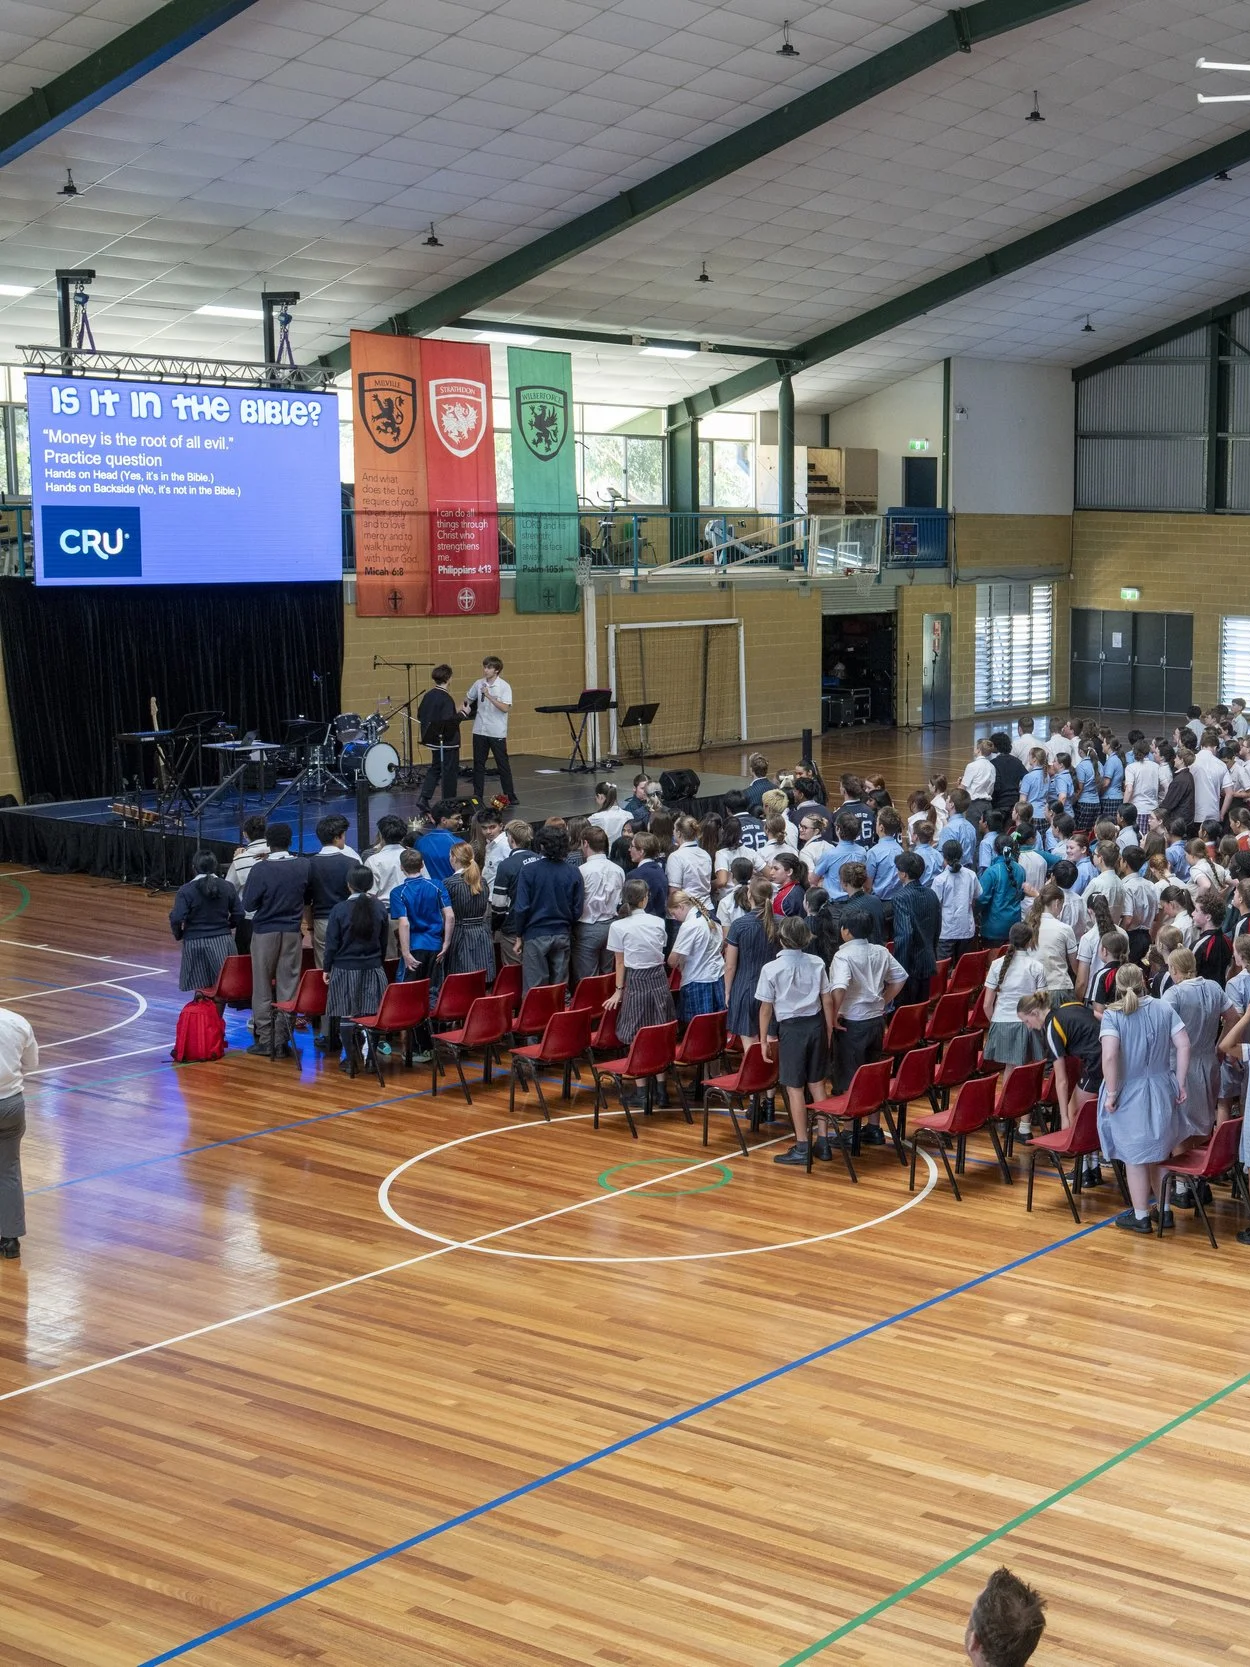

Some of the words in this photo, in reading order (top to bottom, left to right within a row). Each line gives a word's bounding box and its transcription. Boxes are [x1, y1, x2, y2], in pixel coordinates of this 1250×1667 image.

[439, 386, 476, 395] STRATHDON
[522, 392, 562, 403] WILBERFORCE
[100, 432, 112, 445] is
[116, 433, 137, 446] the
[141, 435, 166, 448] root
[170, 435, 183, 448] of
[186, 435, 201, 449] all
[44, 449, 101, 464] Practice
[106, 453, 162, 468] question
[45, 468, 76, 479] Hands
[78, 471, 91, 479] on
[93, 470, 118, 480] Head
[120, 470, 144, 482] (Yes,
[161, 472, 169, 481] in
[171, 472, 185, 482] the
[187, 472, 214, 484] Bible.)
[362, 473, 378, 482] And
[380, 476, 398, 484] what
[45, 482, 77, 492] Hands
[79, 485, 91, 493] on
[94, 483, 135, 493] Backside
[137, 484, 157, 495] (No,
[173, 486, 187, 494] not
[189, 485, 197, 494] in
[199, 485, 212, 495] the
[214, 486, 241, 496] Bible.)
[362, 485, 381, 494] does
[383, 487, 395, 495] the
[398, 486, 414, 495] Lord
[391, 497, 399, 506] of
[401, 498, 419, 509] you?
[455, 507, 465, 517] do
[467, 507, 475, 517] all
[363, 519, 379, 528] and
[390, 520, 405, 529] love
[437, 519, 460, 530] things
[461, 518, 489, 531] through
[363, 532, 386, 542] mercy
[437, 530, 459, 540] Christ
[460, 530, 475, 540] who
[59, 527, 124, 560] CRU
[364, 542, 382, 551] walk
[383, 542, 411, 554] humbly
[437, 541, 480, 553] strengthens
[364, 553, 380, 563] with
[382, 555, 400, 565] your
[364, 566, 389, 576] Micah
[391, 567, 404, 576] 6:8
[438, 565, 477, 577] Philippians
[477, 564, 492, 574] 4:13
[522, 564, 543, 573] Psalm
